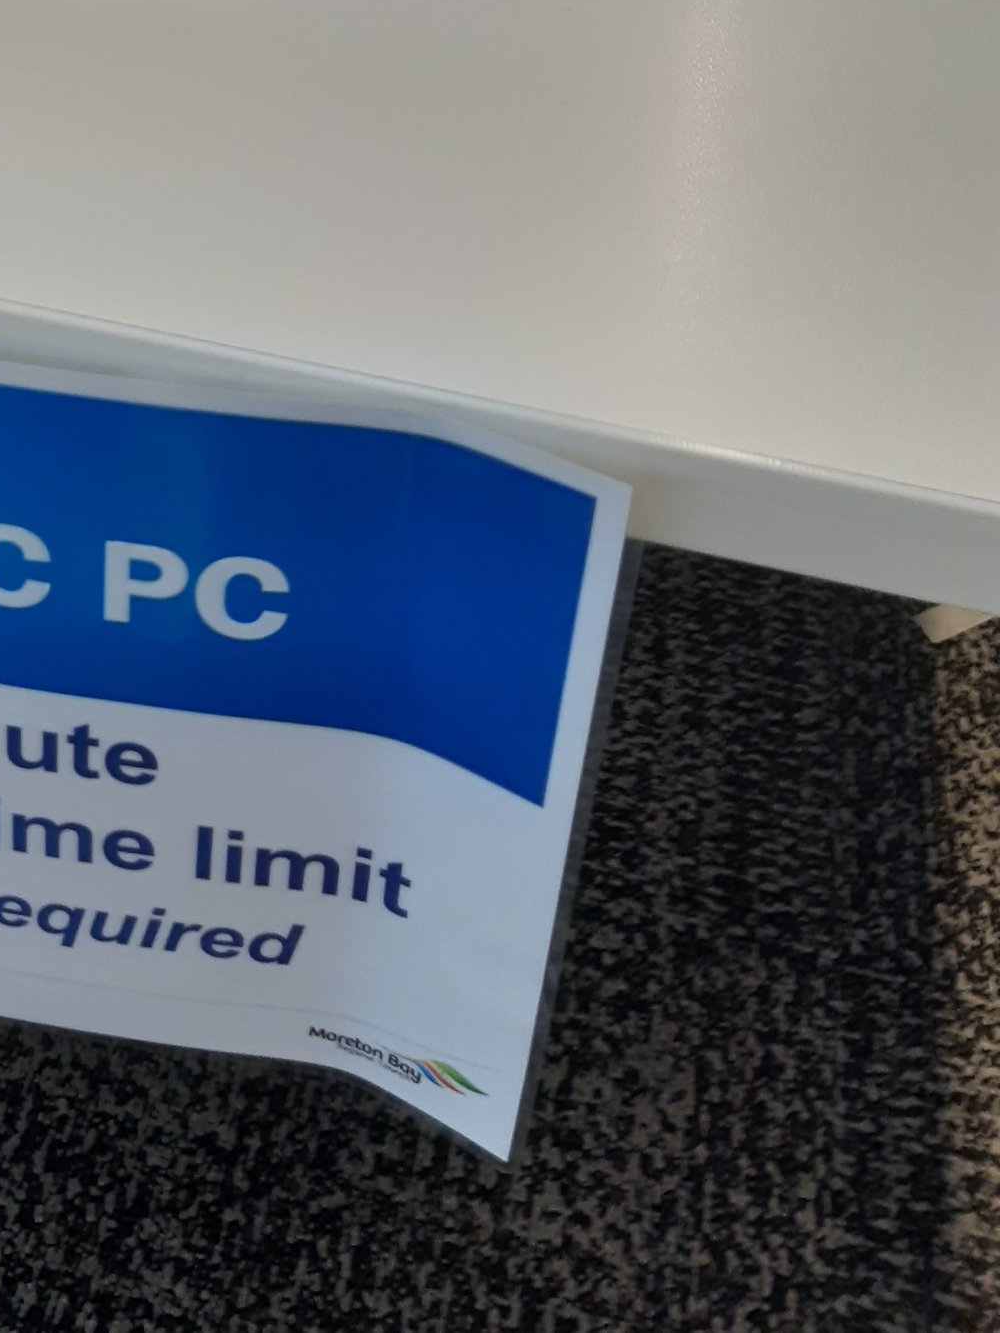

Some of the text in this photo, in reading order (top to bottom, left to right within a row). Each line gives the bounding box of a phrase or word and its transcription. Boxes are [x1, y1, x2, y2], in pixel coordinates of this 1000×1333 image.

[102, 540, 291, 641] PC
[195, 825, 411, 919] limit
[308, 1025, 384, 1060] Moreton
[388, 1053, 422, 1084] Bay
